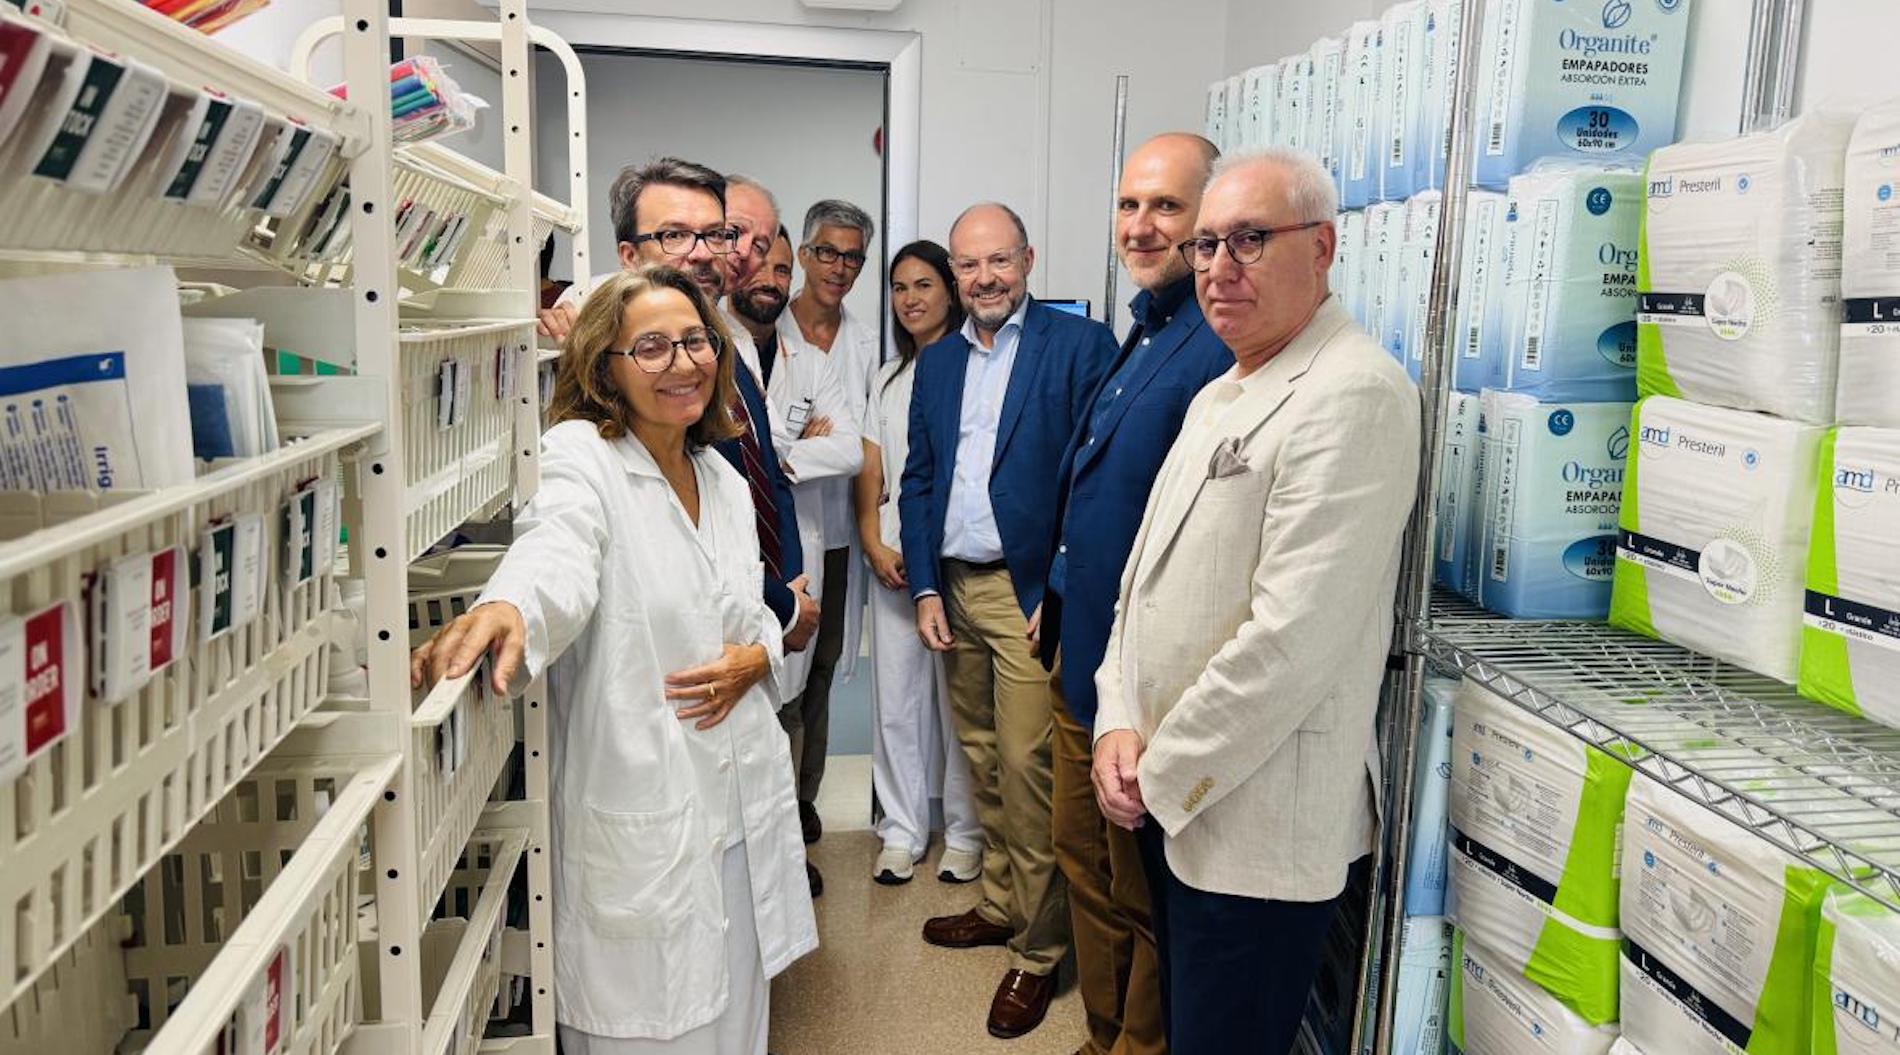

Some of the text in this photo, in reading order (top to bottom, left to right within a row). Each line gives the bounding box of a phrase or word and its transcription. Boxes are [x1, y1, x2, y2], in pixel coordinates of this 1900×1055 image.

[1562, 59, 1648, 75] EMPAPADORES
[1618, 77, 1647, 86] EXTRA
[1589, 111, 1609, 128] 30
[1576, 128, 1618, 139] Unidades
[1679, 177, 1721, 193] Presteril
[1642, 296, 1651, 311] L
[1873, 301, 1884, 319] L
[1678, 435, 1726, 458] Presteril
[1836, 468, 1875, 489] amd
[1627, 533, 1636, 549] L
[1825, 598, 1836, 616] L
[1466, 840, 1474, 856] L
[1641, 952, 1651, 972] L
[1835, 991, 1880, 1030] amd
